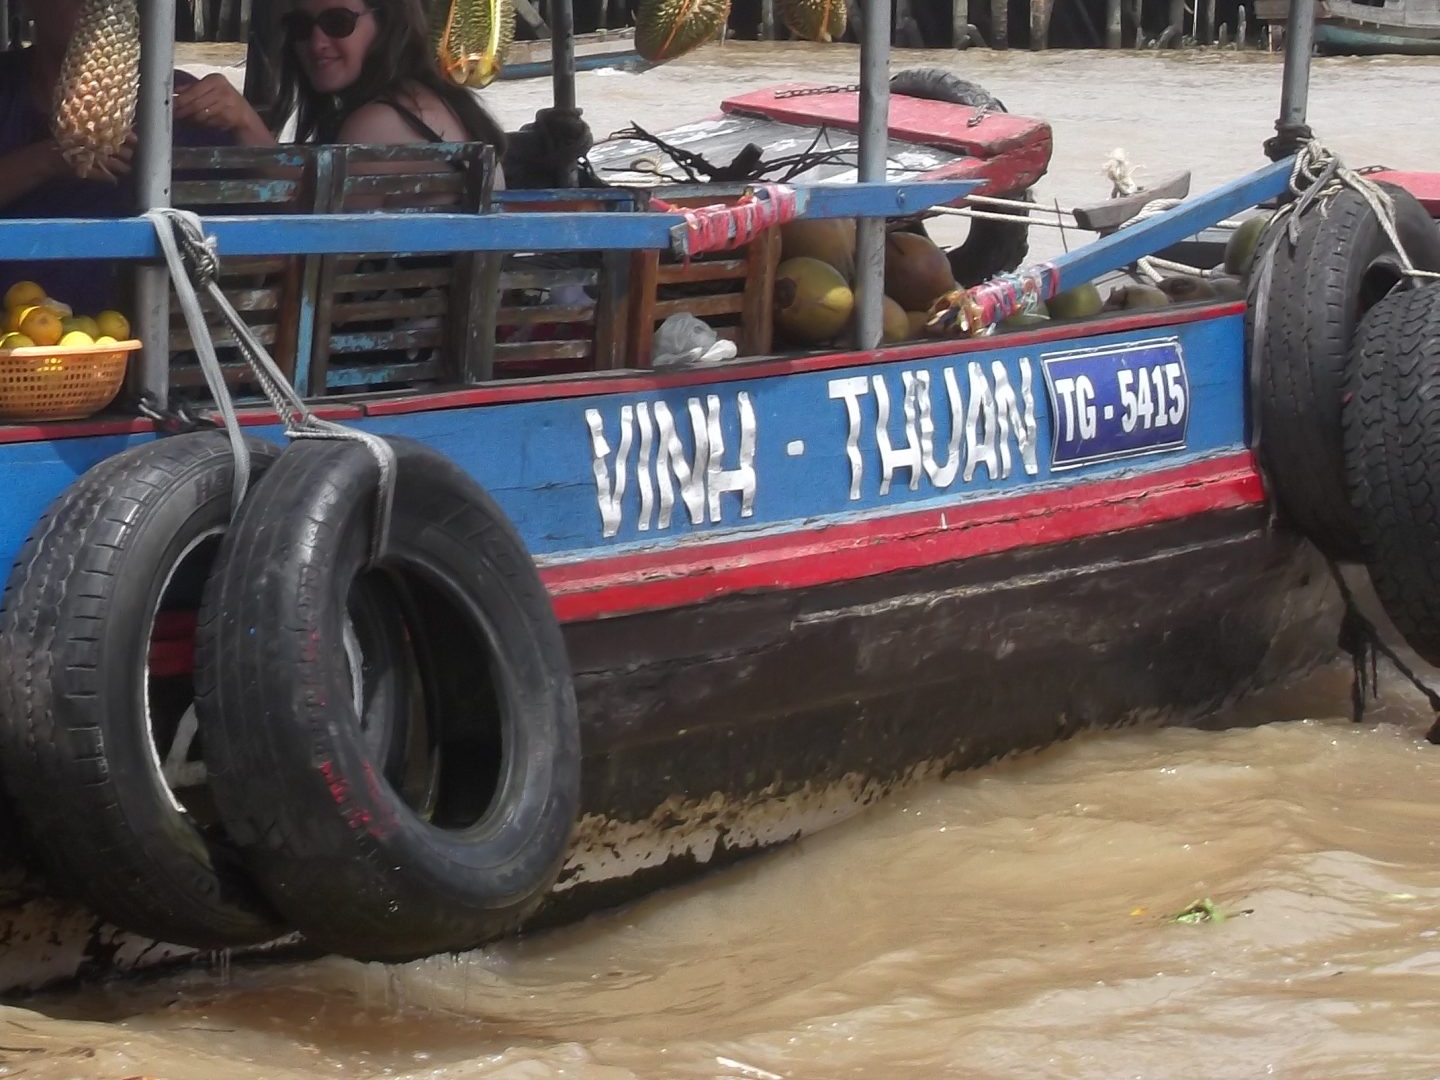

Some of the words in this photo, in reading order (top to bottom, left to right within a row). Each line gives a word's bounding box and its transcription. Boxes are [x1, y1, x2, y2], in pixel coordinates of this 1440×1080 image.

[585, 392, 756, 537] VINH
[828, 357, 1038, 500] THUAN
[1055, 377, 1097, 442] TG
[1120, 361, 1186, 428] 5415
